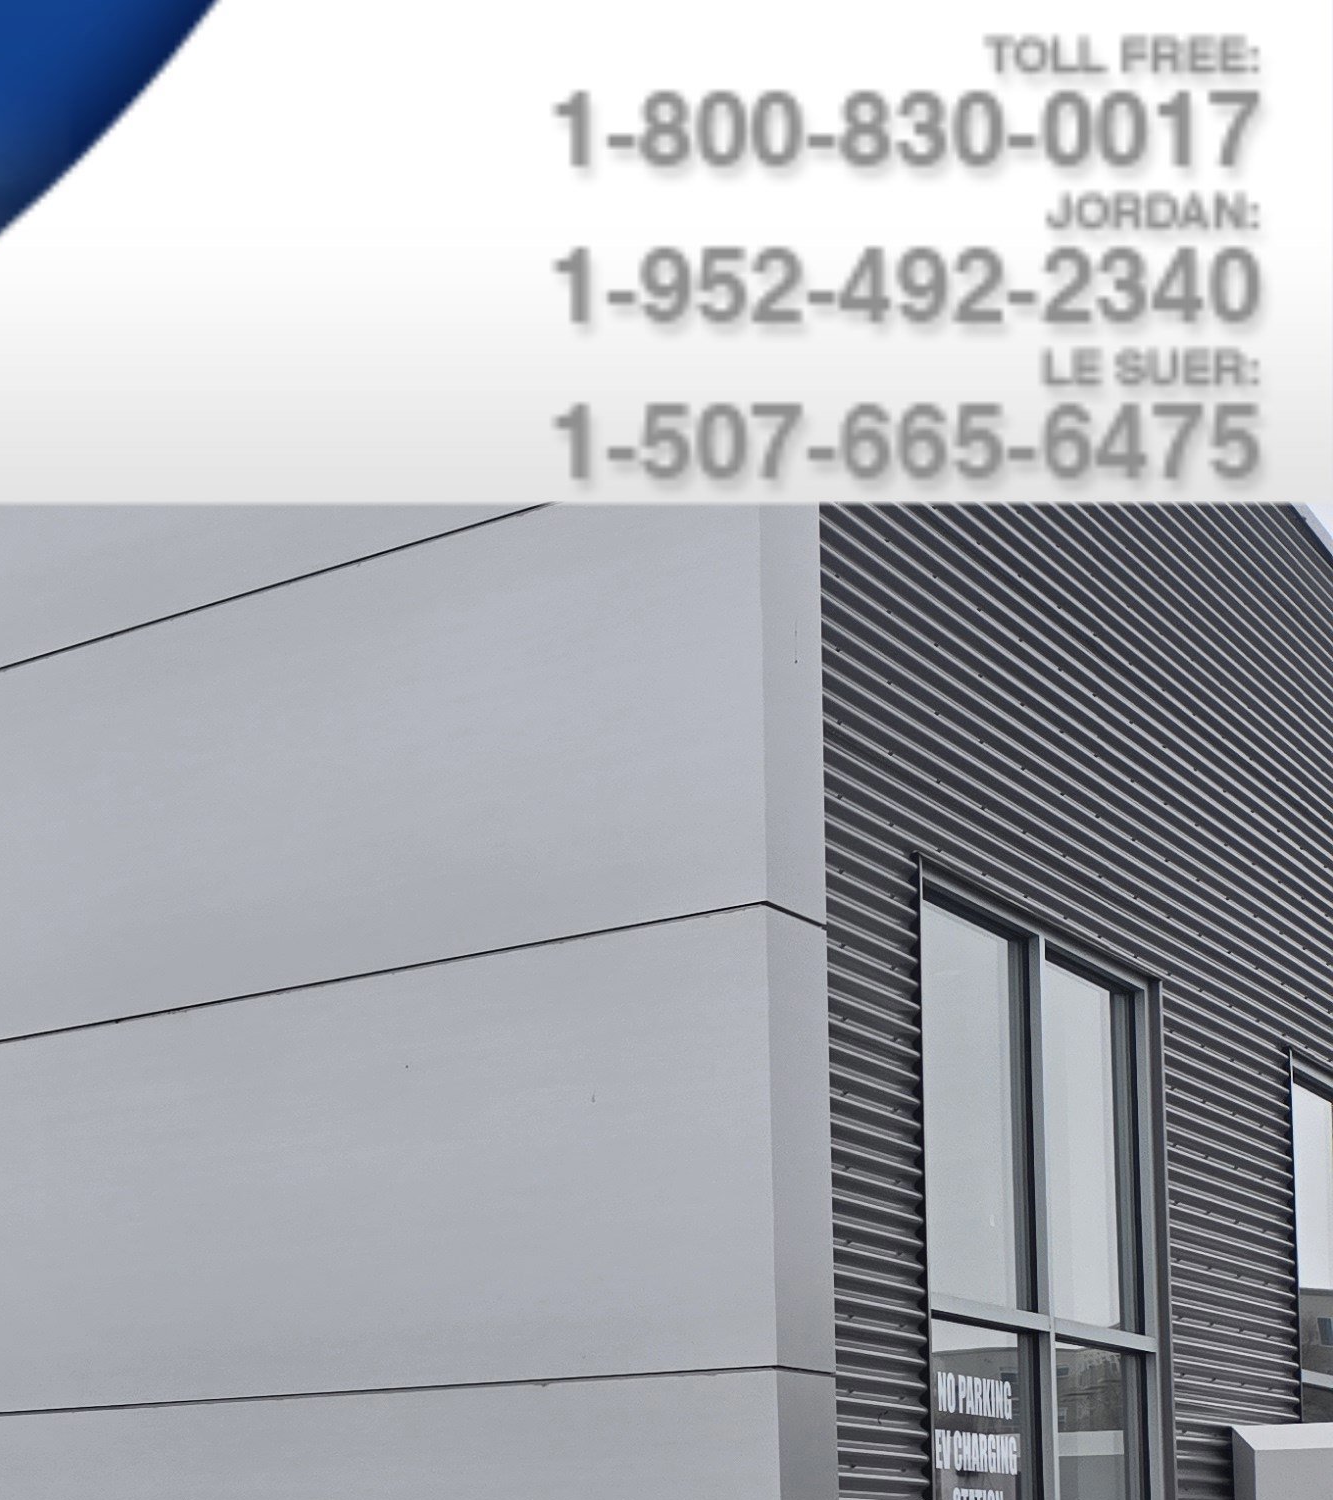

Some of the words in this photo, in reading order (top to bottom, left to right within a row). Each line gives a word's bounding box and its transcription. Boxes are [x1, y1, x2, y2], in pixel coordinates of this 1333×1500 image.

[937, 1371, 956, 1414] NO
[958, 1374, 1013, 1420] PARKING
[934, 1428, 951, 1470] EV
[953, 1430, 1018, 1476] CHARGING
